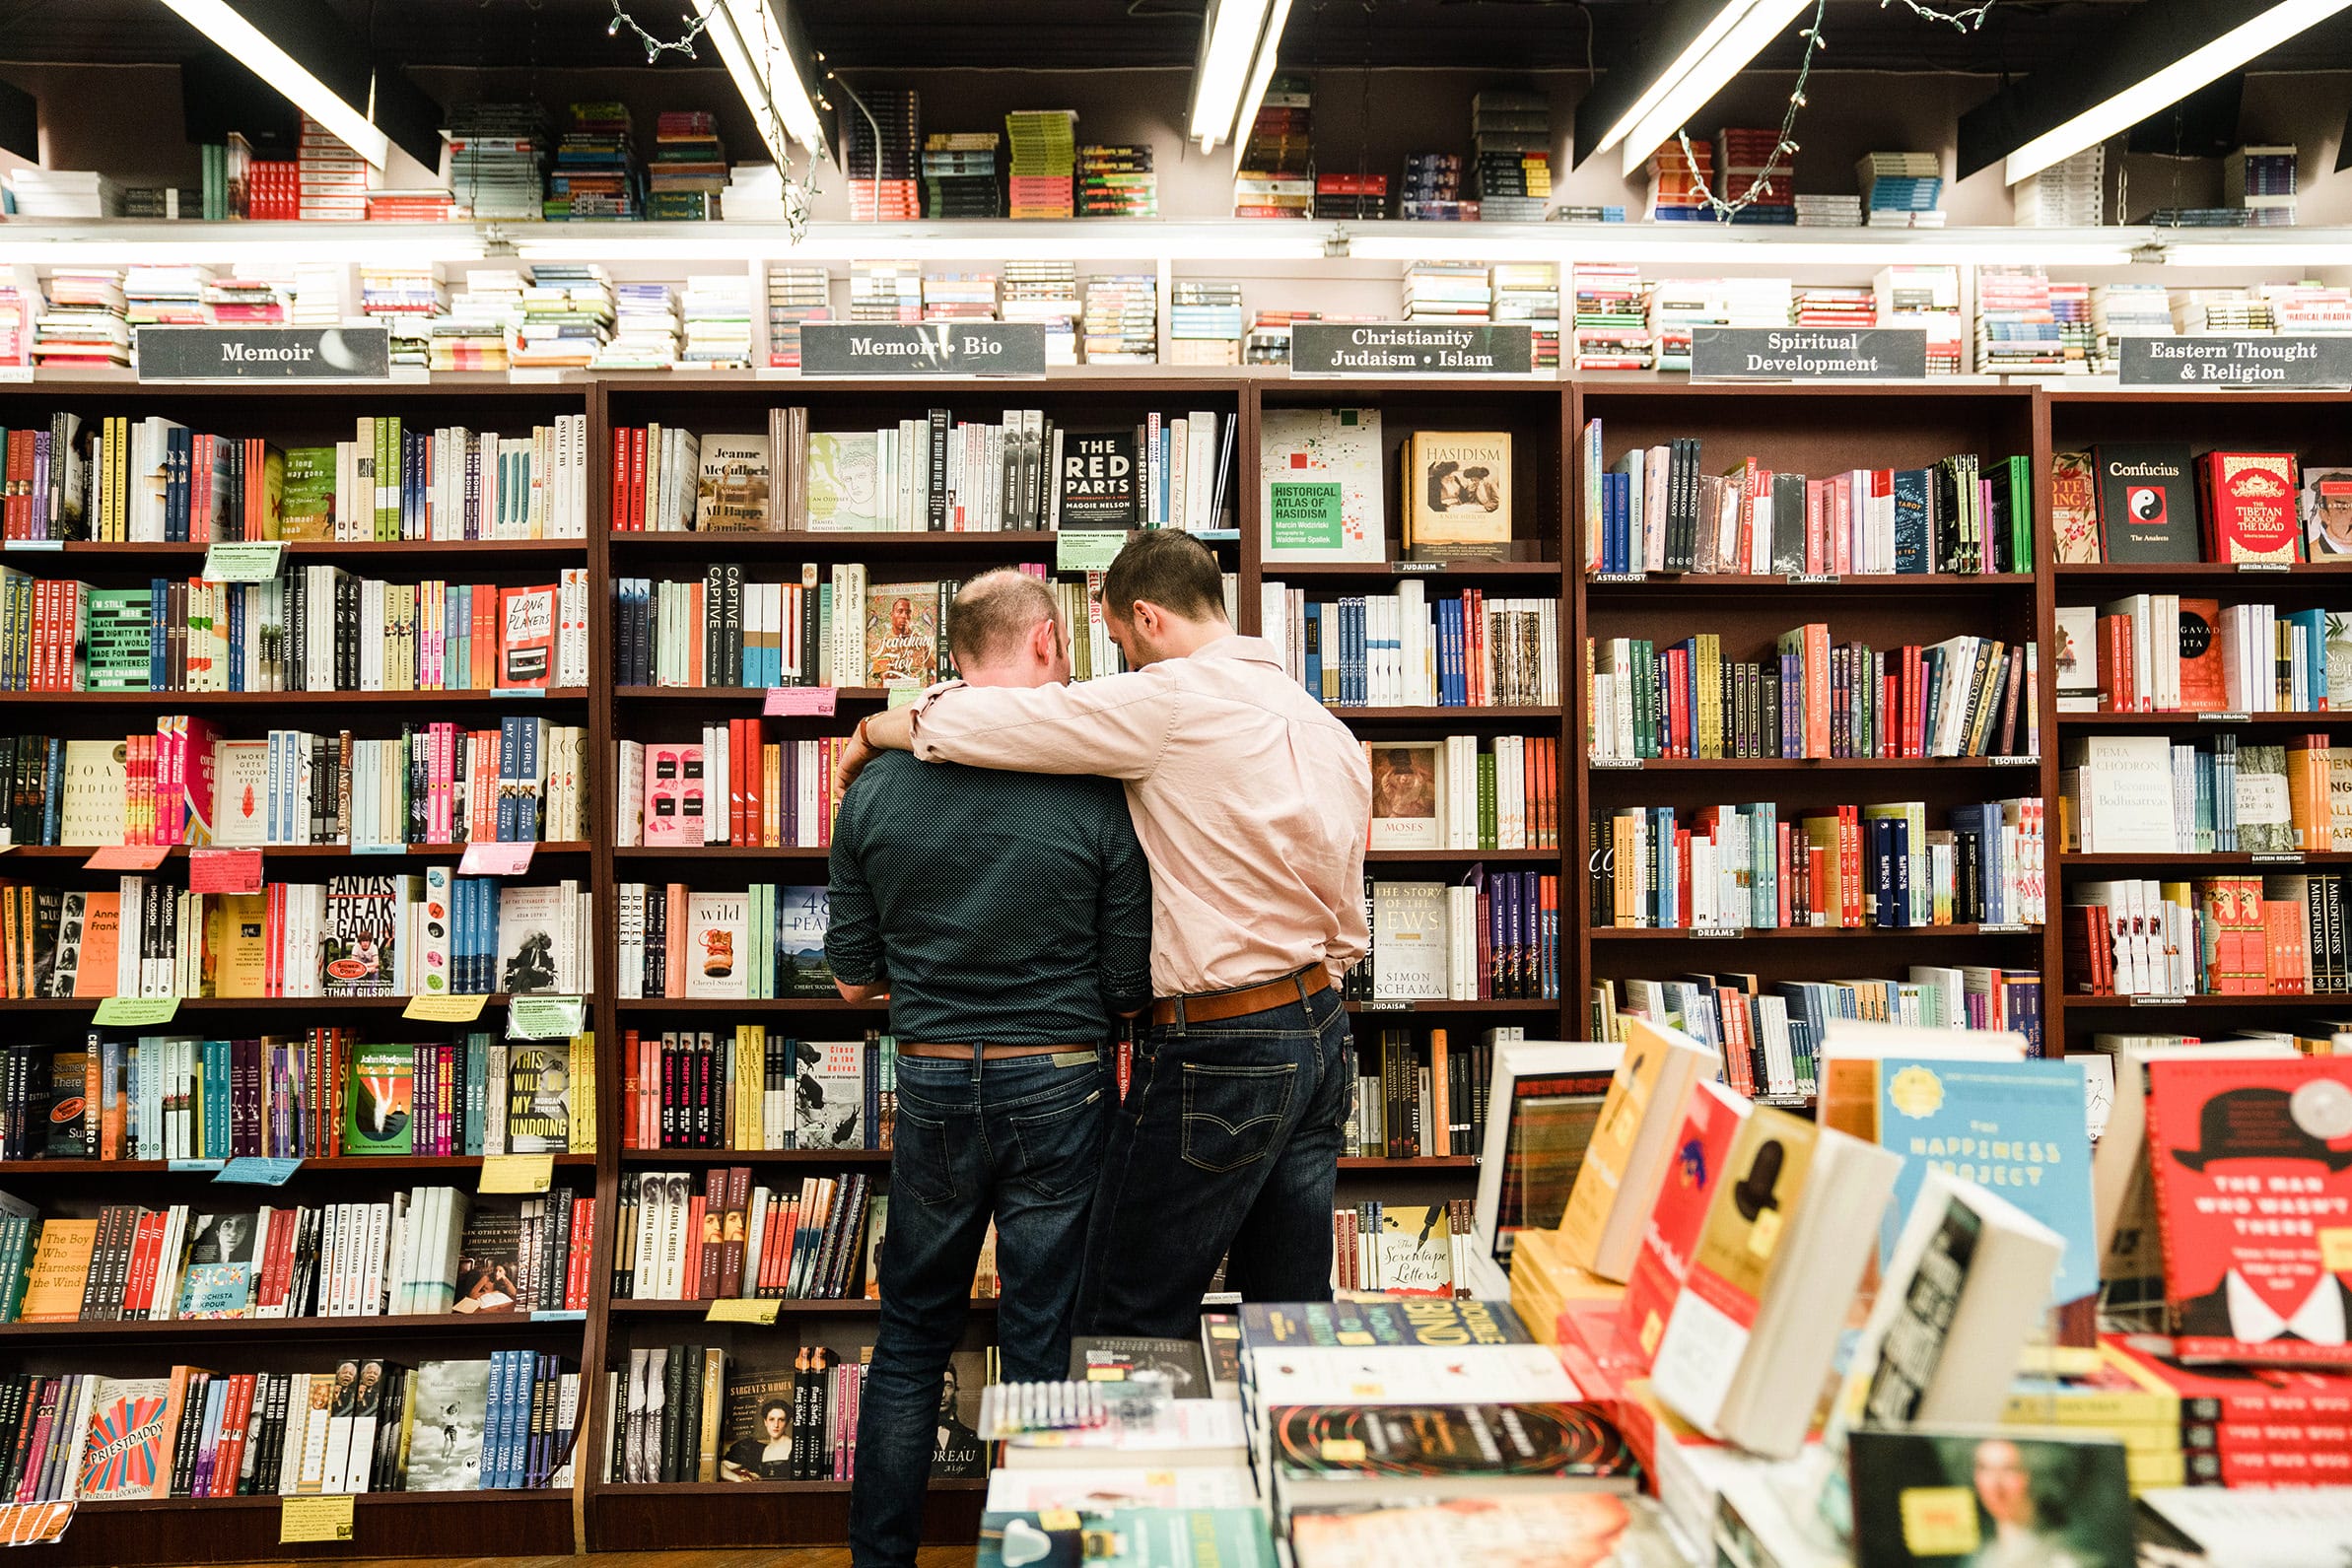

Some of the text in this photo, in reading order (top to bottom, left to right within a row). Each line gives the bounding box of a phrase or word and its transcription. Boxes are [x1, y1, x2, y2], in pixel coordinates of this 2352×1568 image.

[851, 337, 1003, 356] Memoir Bio
[1351, 329, 1473, 348] Christianity
[1767, 333, 1858, 352] Spiritual
[221, 342, 314, 362] Memoir
[1331, 350, 1493, 367] Judaism Islam
[2150, 342, 2317, 361] Eastern Thought
[1747, 355, 1878, 374] Development
[2180, 364, 2286, 382] & Religion
[714, 447, 760, 460] Jeanne
[1078, 441, 1115, 454] THE
[1426, 448, 1500, 461] HASIDISM
[295, 459, 313, 470] long
[705, 464, 769, 477] McCulloch
[1066, 455, 1130, 477] RED
[2110, 462, 2179, 478] Confucius
[1066, 479, 1130, 495] PARTS
[1276, 487, 1337, 497] HISTORICAL
[1276, 498, 1325, 508] ATLAS OF
[1898, 500, 1921, 511] TAROT
[2236, 507, 2282, 516] TIBETAN
[1276, 509, 1327, 518] HASIDISM
[2238, 522, 2284, 532] THE DEAD
[1799, 575, 1829, 583] TAROT
[512, 597, 544, 614] LONG
[710, 567, 721, 629] CAPTIVE
[726, 567, 738, 629] CAPTIVE
[282, 587, 292, 662] THIS STOPS TODAY
[506, 614, 551, 633] PLAYERS
[90, 669, 113, 678] AUSTIN
[523, 722, 531, 738] MY
[504, 723, 514, 774] MY GIRLS
[2096, 747, 2129, 757] PEMA
[1384, 823, 1424, 833] MOSES
[1376, 887, 1441, 898] THE STORY
[1386, 899, 1431, 908] OF THE
[93, 910, 119, 919] Anne
[620, 895, 630, 946] DRIVEN
[632, 895, 642, 946] DRIVEN
[699, 905, 740, 921] wild
[2310, 883, 2323, 955] MINDFULNESS
[2327, 883, 2341, 955] MINDFULNESS
[91, 921, 118, 931] Frank
[692, 979, 743, 988] Cheryl Strayed
[1386, 973, 1430, 982] SIMON
[1376, 985, 1442, 994] SCHAMA
[515, 1050, 544, 1070] THIS
[86, 1034, 97, 1143] CRUX JEAN GUERRERO
[514, 1073, 542, 1092] WILL
[512, 1096, 531, 1115] MY
[534, 1105, 561, 1114] JERKINS
[511, 1119, 567, 1137] UNDOING
[1908, 1136, 2061, 1164] HAPPINESS
[2213, 1177, 2323, 1193] THE MAN
[2194, 1197, 2349, 1214] WHO WASN'T
[644, 1205, 655, 1261] AGATHA CHRISTIE
[667, 1205, 679, 1261] AGATHA CHRISTIE
[2233, 1218, 2315, 1236] THERE
[46, 1234, 90, 1247] The Boy
[1397, 1239, 1413, 1248] The
[42, 1248, 68, 1258] Who
[189, 1265, 245, 1287] SICK
[1391, 1263, 1437, 1283] Letters
[34, 1277, 81, 1287] the Wind
[489, 1364, 501, 1405] Butterfly
[504, 1364, 516, 1405] Butterfly
[730, 1381, 792, 1396] SARGENT'S WOMEN
[266, 1379, 278, 1418] HAMMER HEAD
[90, 1421, 165, 1465] PRIESTDADDY
